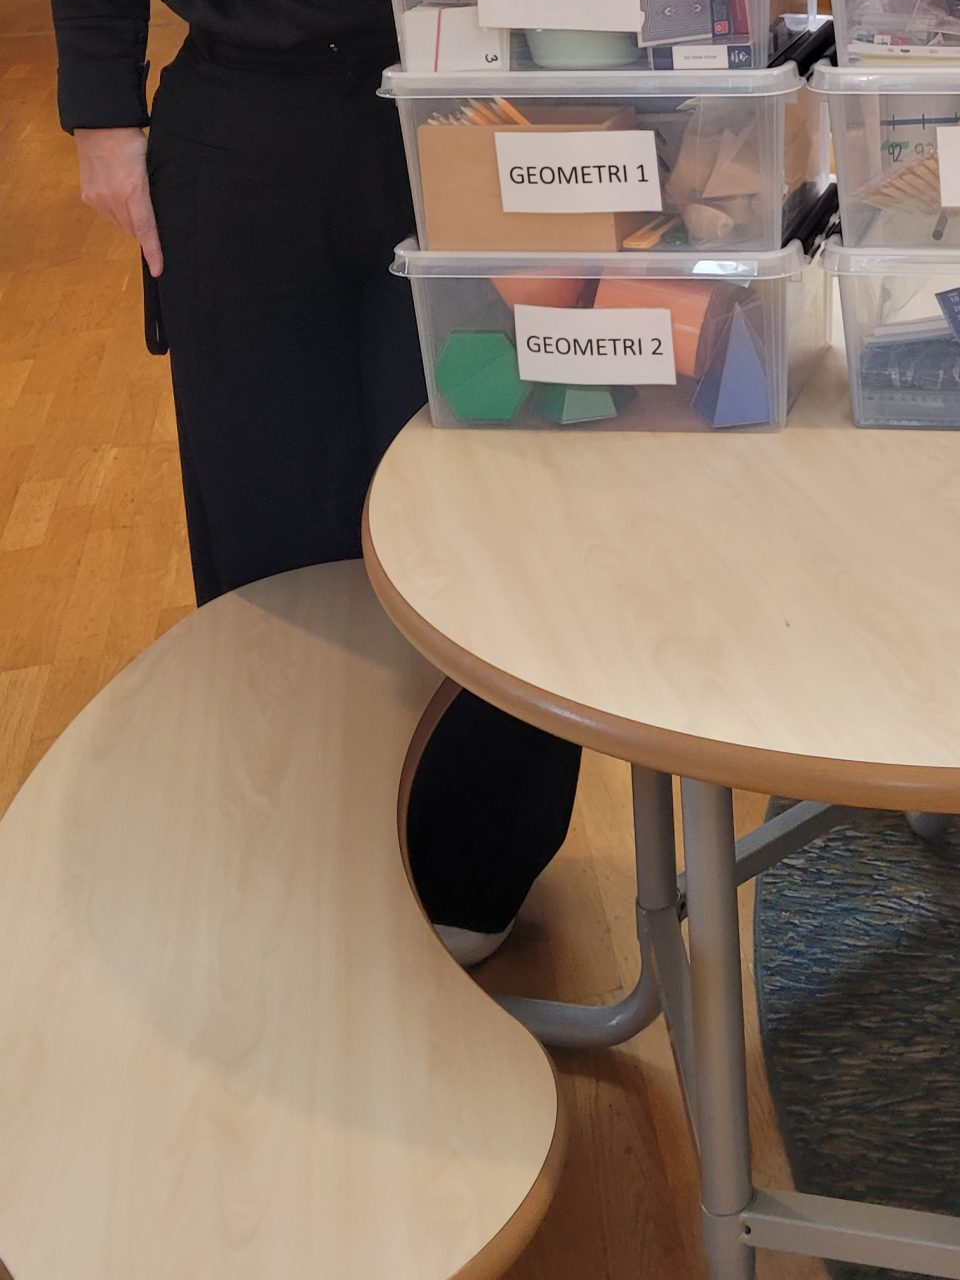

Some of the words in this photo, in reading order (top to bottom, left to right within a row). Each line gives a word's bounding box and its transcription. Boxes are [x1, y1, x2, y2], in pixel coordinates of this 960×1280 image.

[509, 164, 628, 185] GEOMETRI
[636, 164, 649, 183] 1
[526, 335, 643, 356] GEOMETRI
[650, 337, 664, 356] 2
